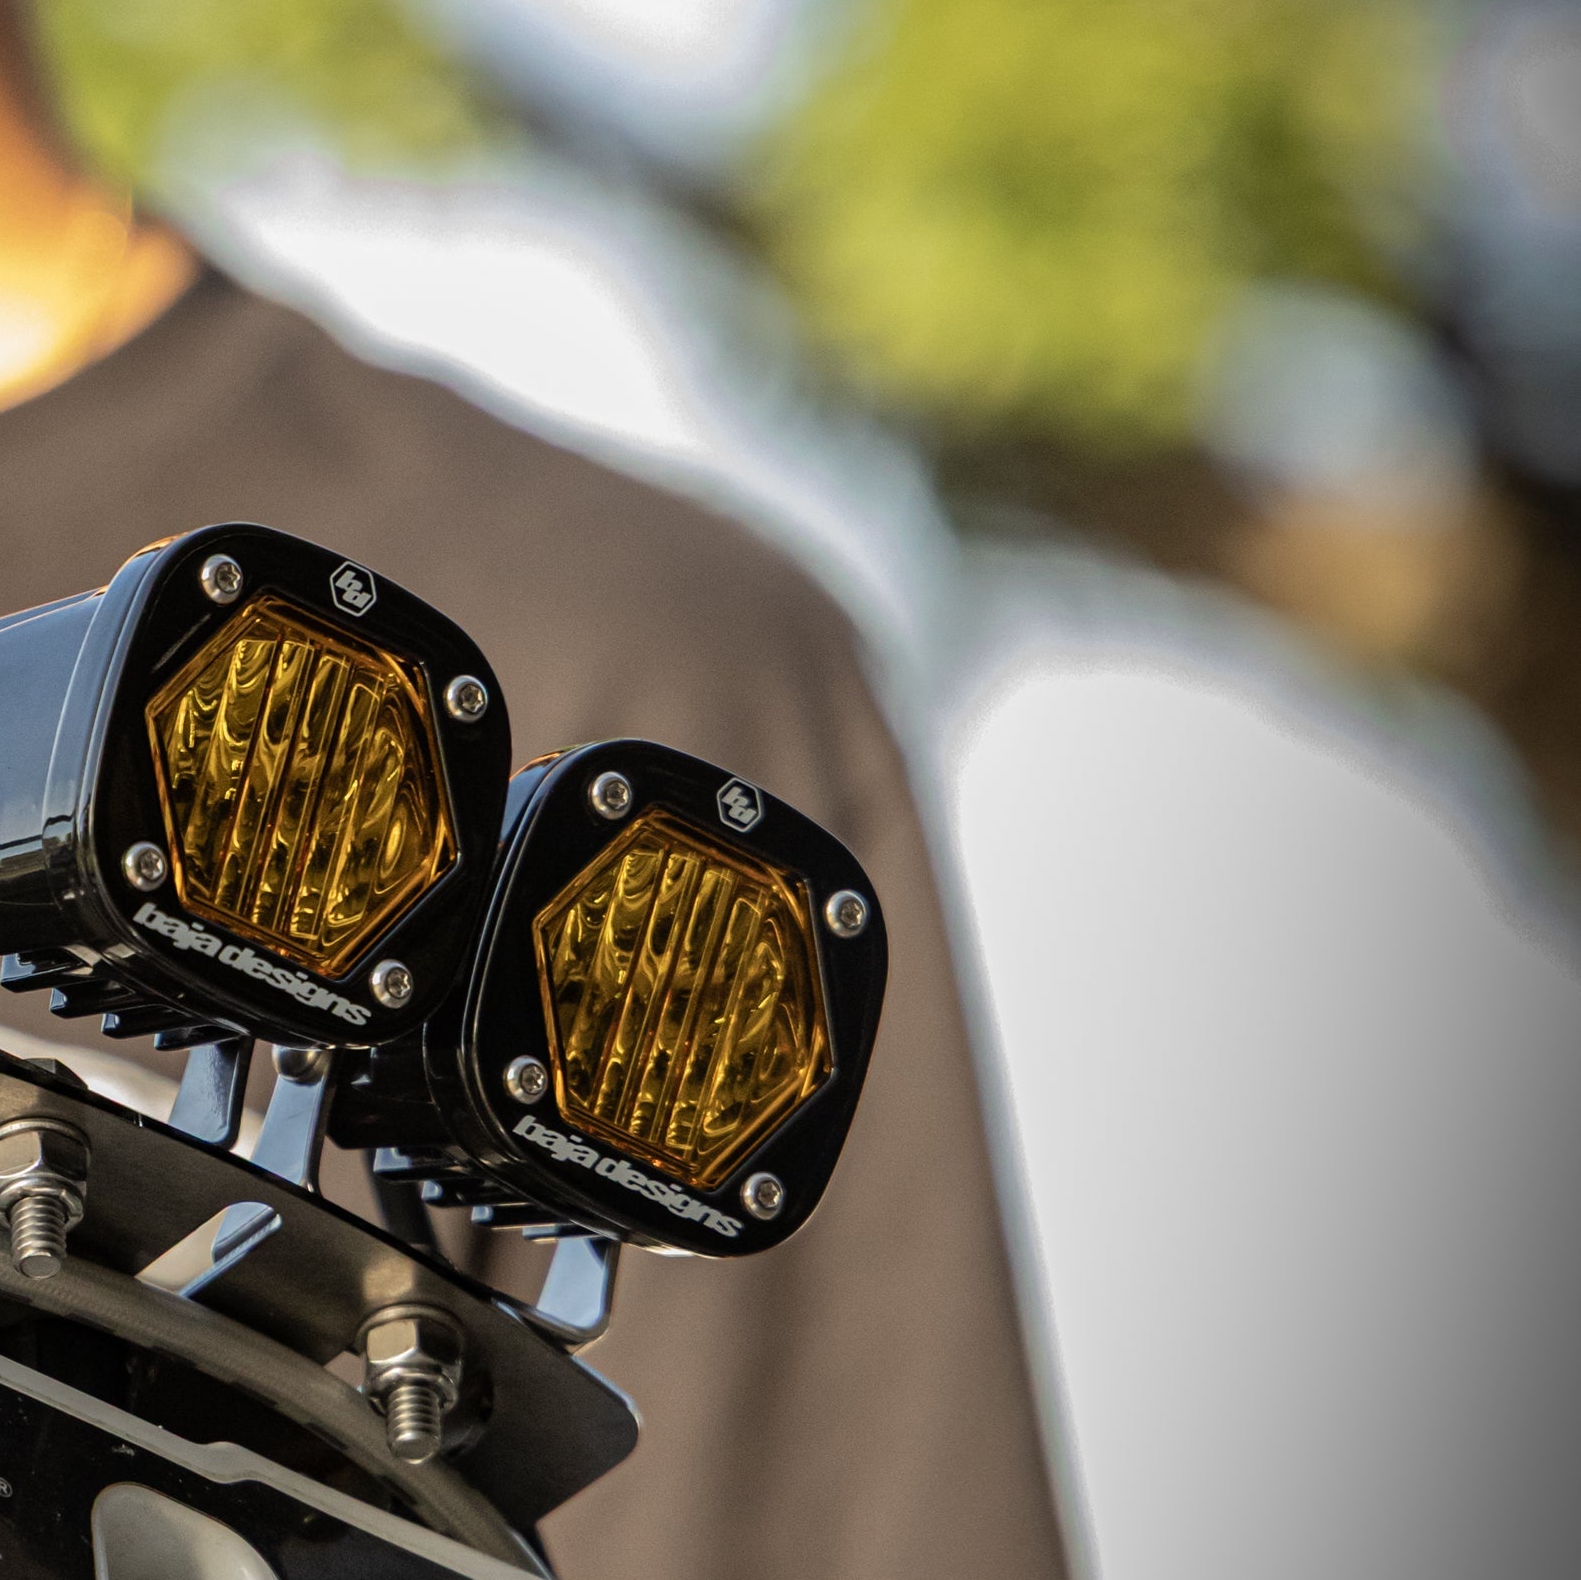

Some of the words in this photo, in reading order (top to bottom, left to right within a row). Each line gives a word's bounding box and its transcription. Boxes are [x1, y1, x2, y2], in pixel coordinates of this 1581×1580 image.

[132, 901, 223, 958] baja
[218, 944, 373, 1026] designs
[511, 1114, 602, 1170] baja
[594, 1158, 744, 1238] designs
